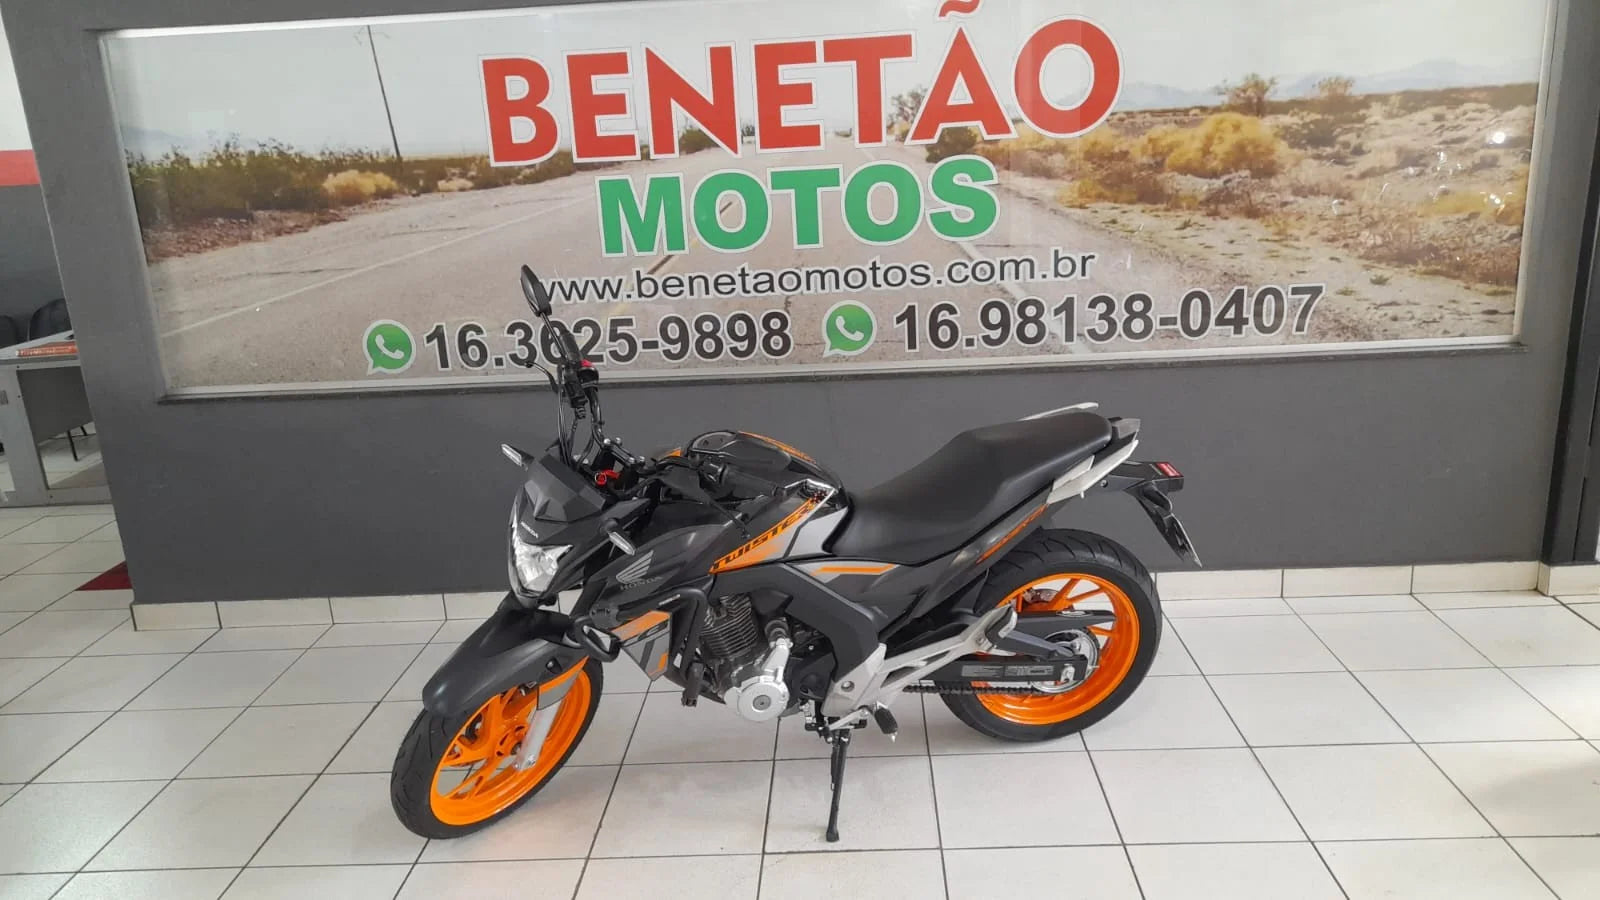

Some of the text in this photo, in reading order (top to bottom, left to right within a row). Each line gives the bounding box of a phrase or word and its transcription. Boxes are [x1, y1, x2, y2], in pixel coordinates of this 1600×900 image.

[481, 0, 1121, 164] BENETÃO
[600, 158, 998, 255] MOTOS
[895, 285, 1325, 350] 16.98138-0407
